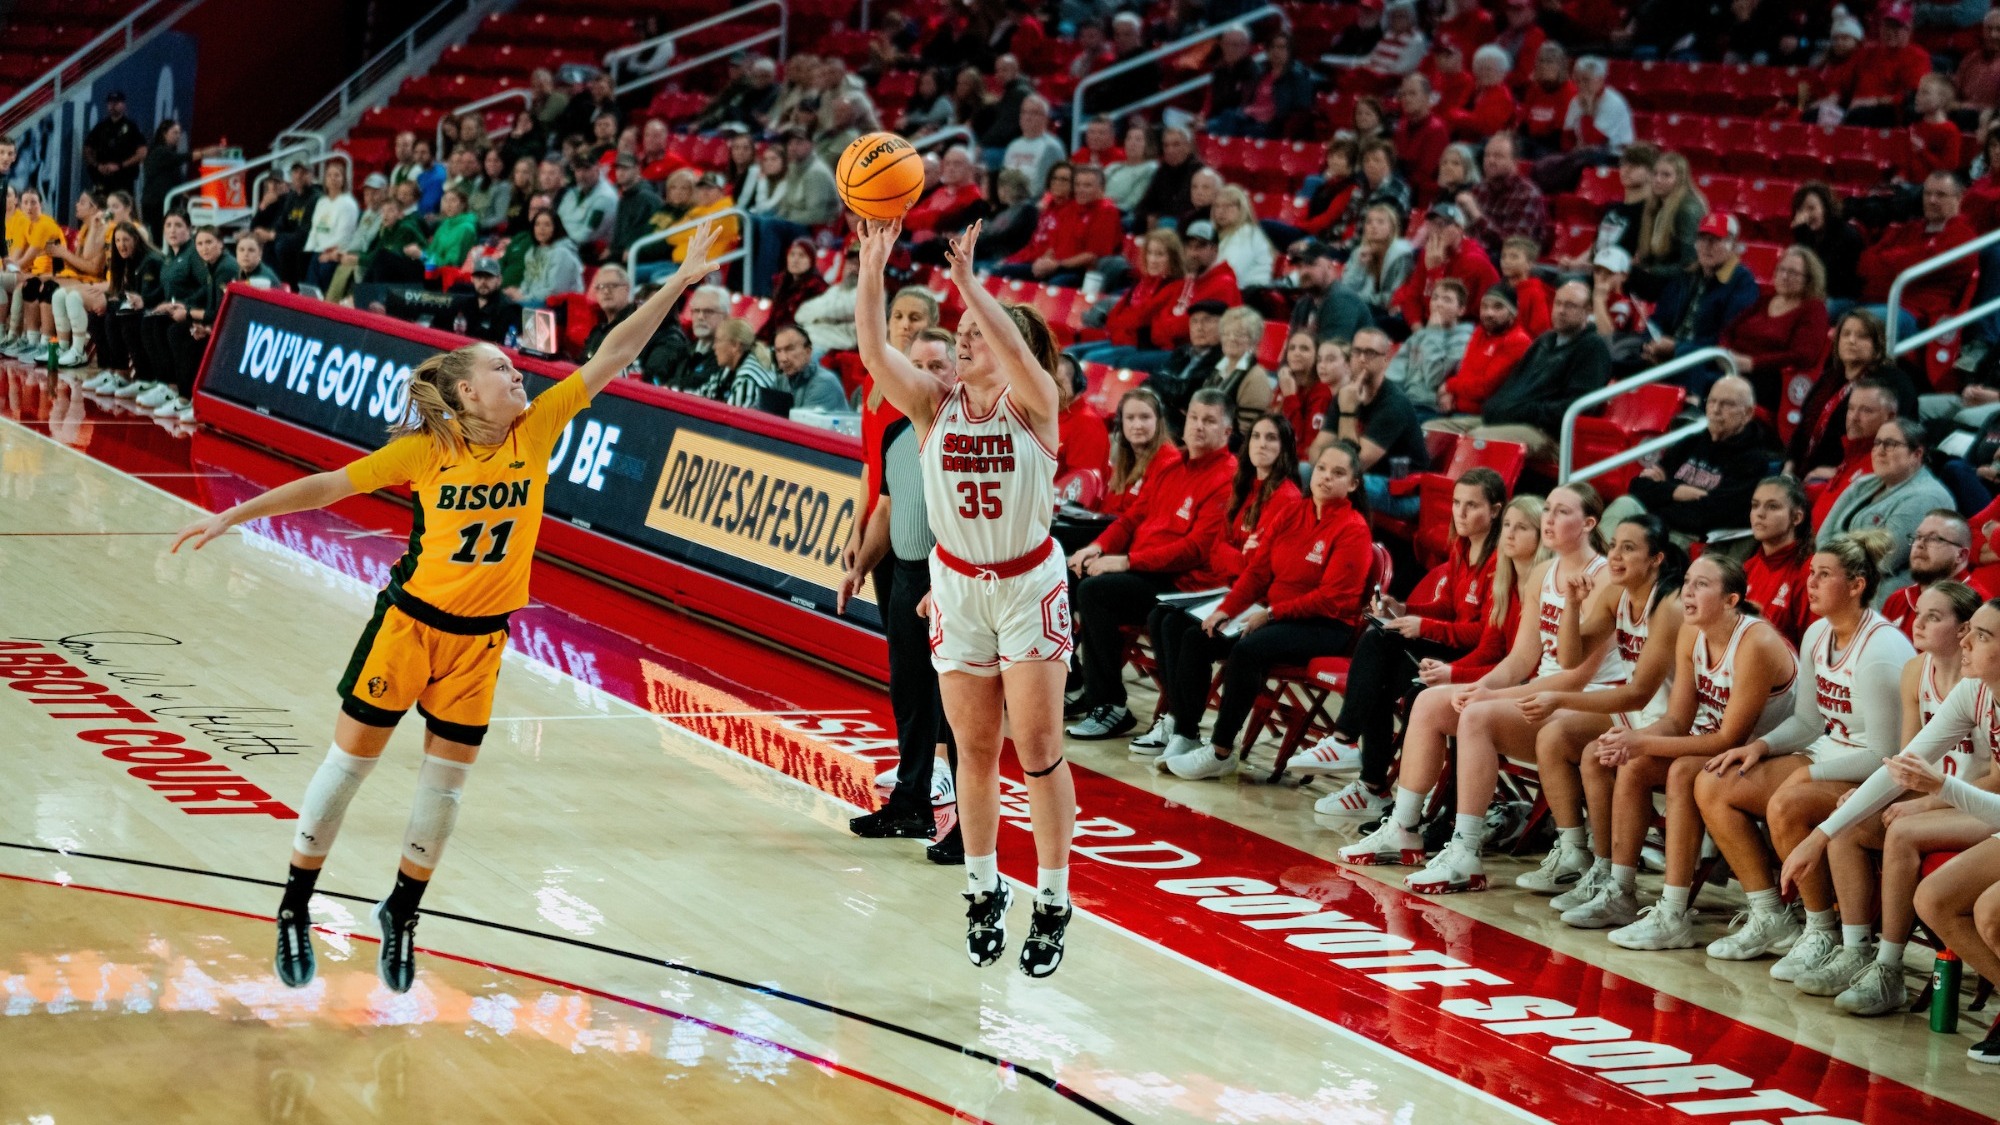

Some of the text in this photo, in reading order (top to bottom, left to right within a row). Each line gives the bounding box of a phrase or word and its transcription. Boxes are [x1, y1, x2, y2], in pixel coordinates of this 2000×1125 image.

[239, 321, 320, 394] YOU'VE
[317, 346, 377, 411] GOT
[568, 418, 621, 492] BE
[942, 432, 1014, 456] SOUTH
[942, 454, 1015, 474] DAKOTA
[436, 479, 531, 510] BISON
[956, 481, 1003, 519] 35
[450, 519, 516, 565] 11
[76, 729, 300, 820] COURT
[1154, 876, 1515, 991] COYOTE
